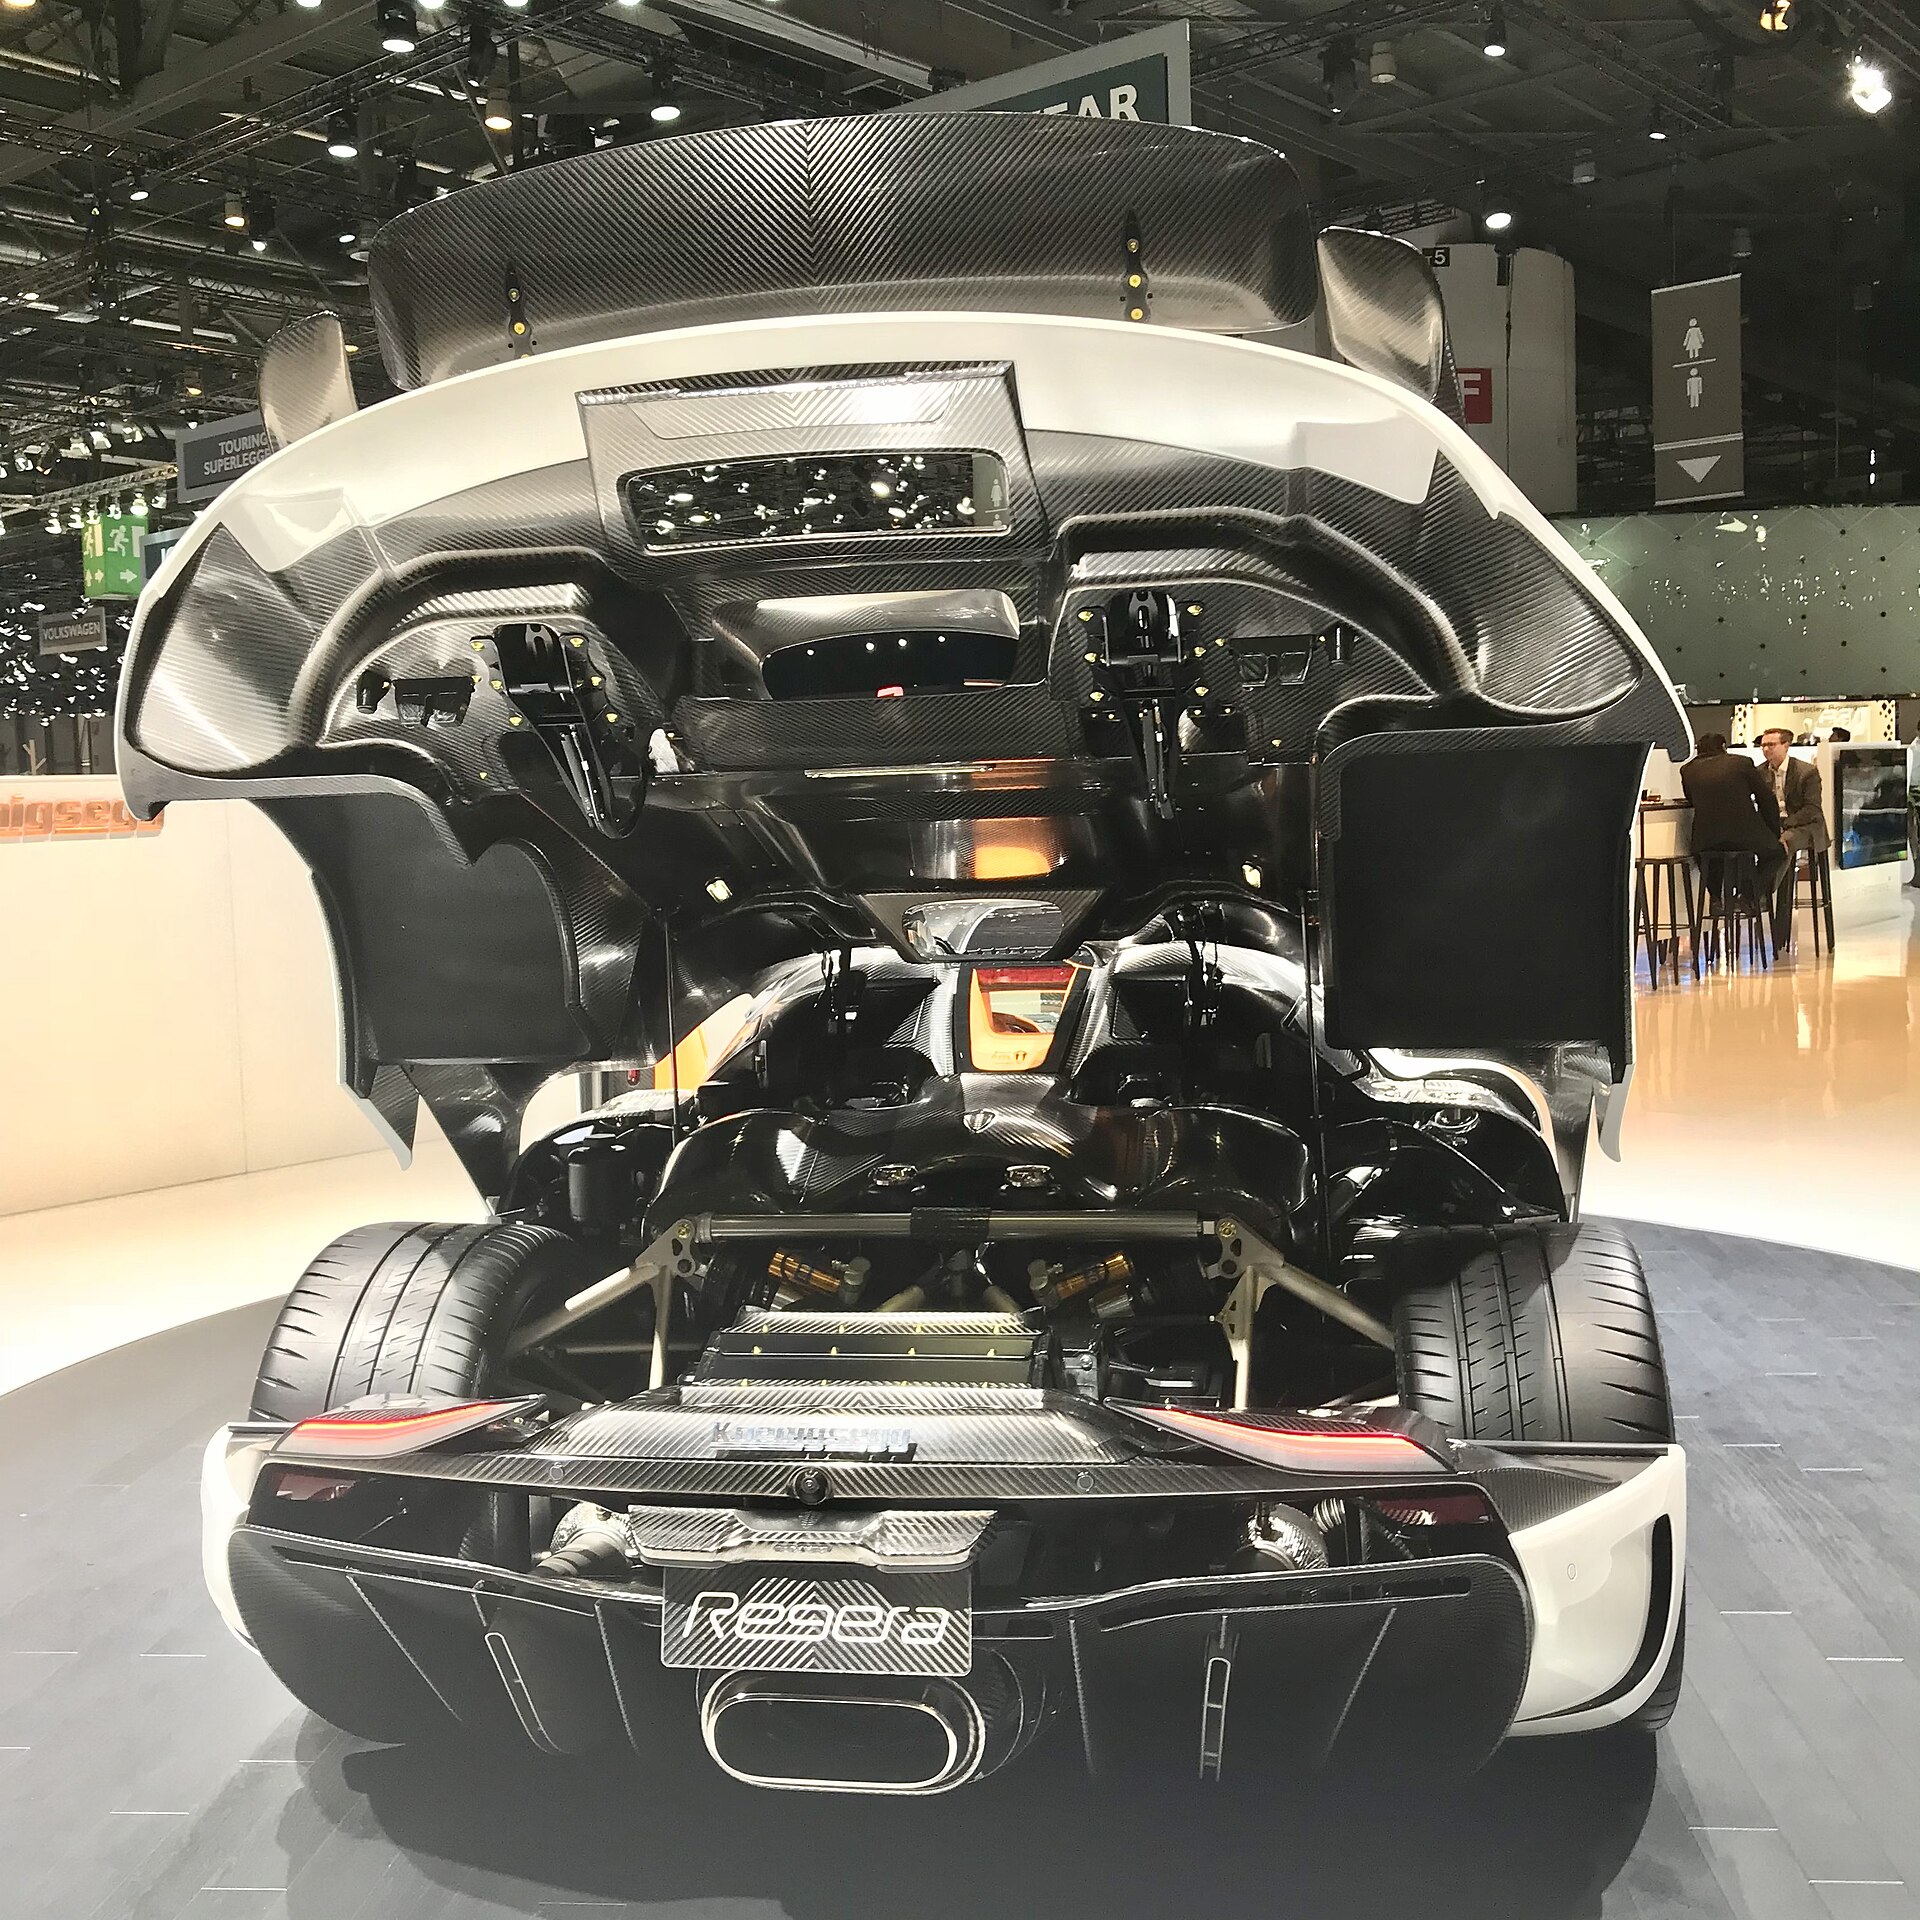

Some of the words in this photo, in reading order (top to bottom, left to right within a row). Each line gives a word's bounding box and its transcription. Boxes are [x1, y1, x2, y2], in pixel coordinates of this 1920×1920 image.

[219, 432, 267, 455] TOURING
[42, 621, 101, 641] VOLKSWAGEN
[682, 1591, 950, 1645] Regera
